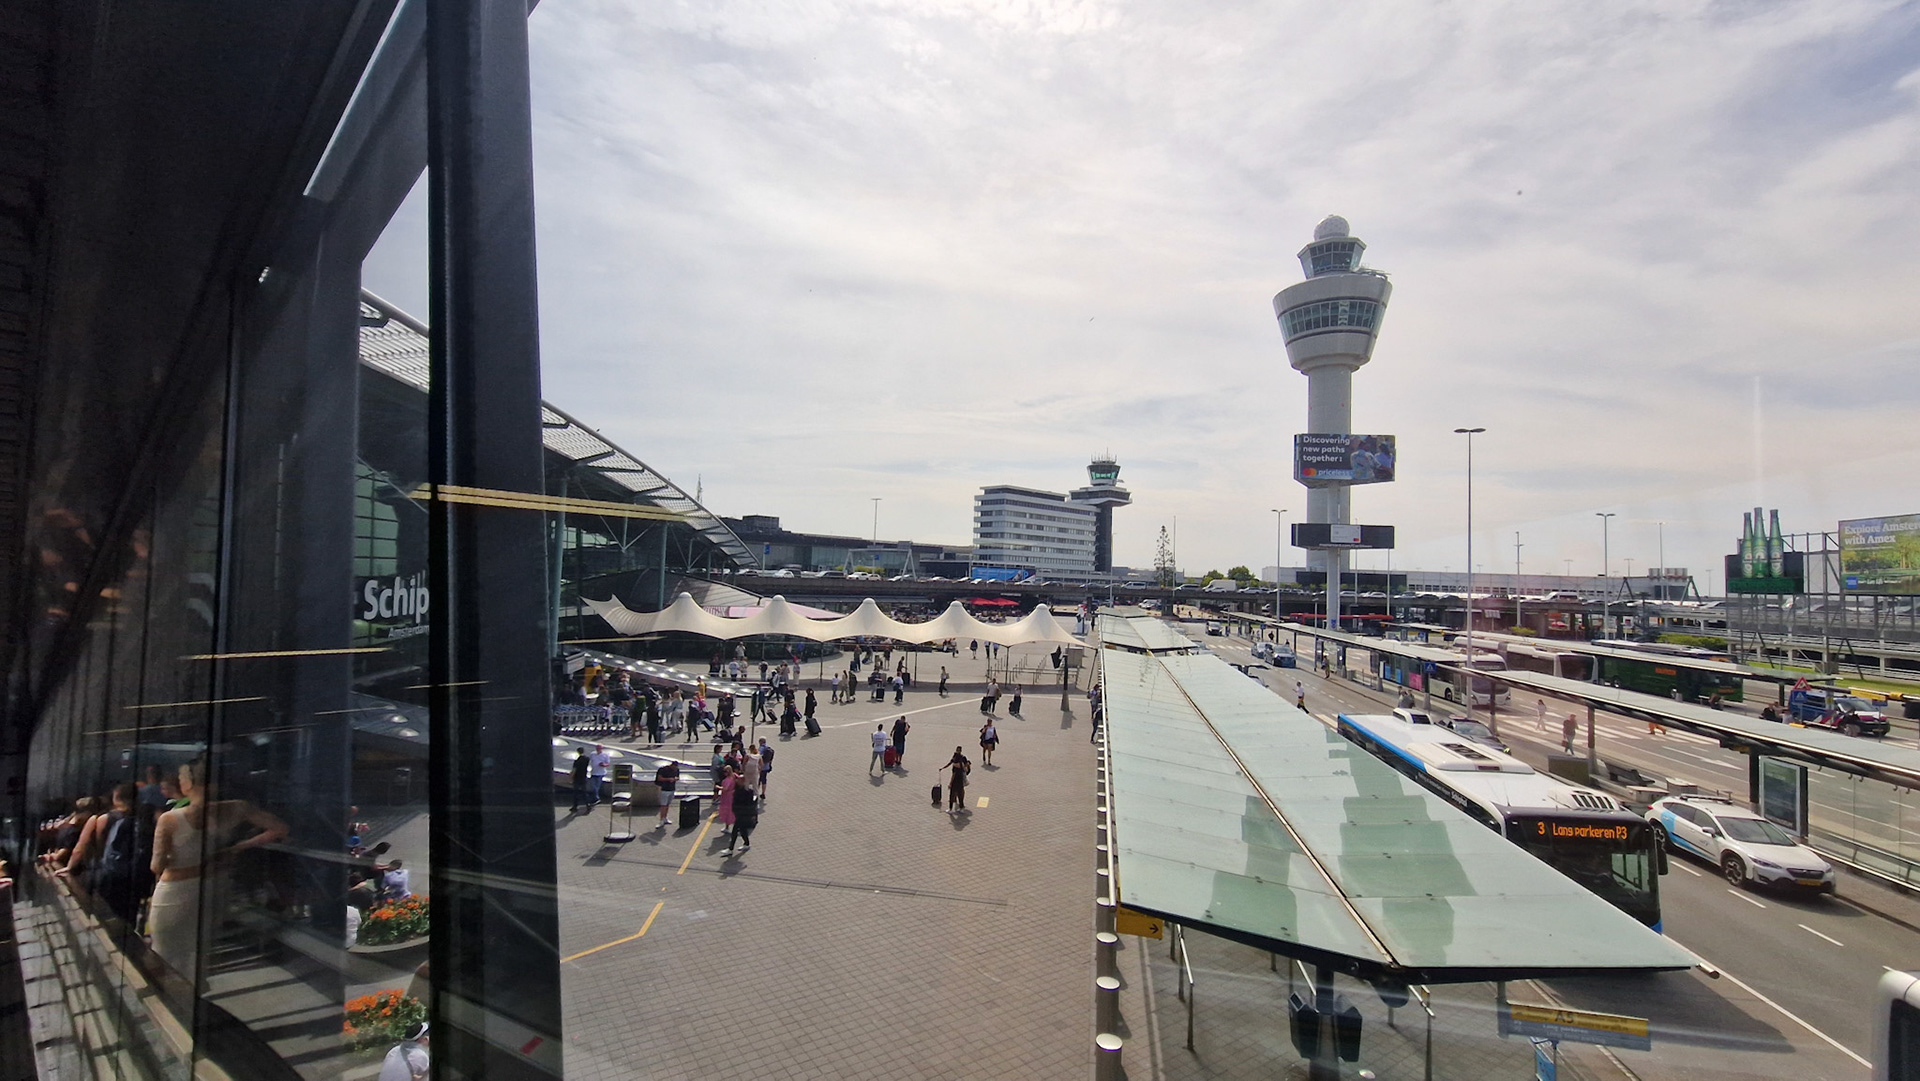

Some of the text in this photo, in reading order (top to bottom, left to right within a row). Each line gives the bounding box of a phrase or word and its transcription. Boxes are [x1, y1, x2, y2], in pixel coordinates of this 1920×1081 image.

[1303, 436, 1350, 445] Discovering
[1321, 446, 1346, 454] paths
[1845, 524, 1880, 535] Explore
[1845, 534, 1896, 545] with Amex
[1537, 821, 1546, 835] 3
[1574, 825, 1615, 839] parkeren
[1615, 826, 1628, 840] P3
